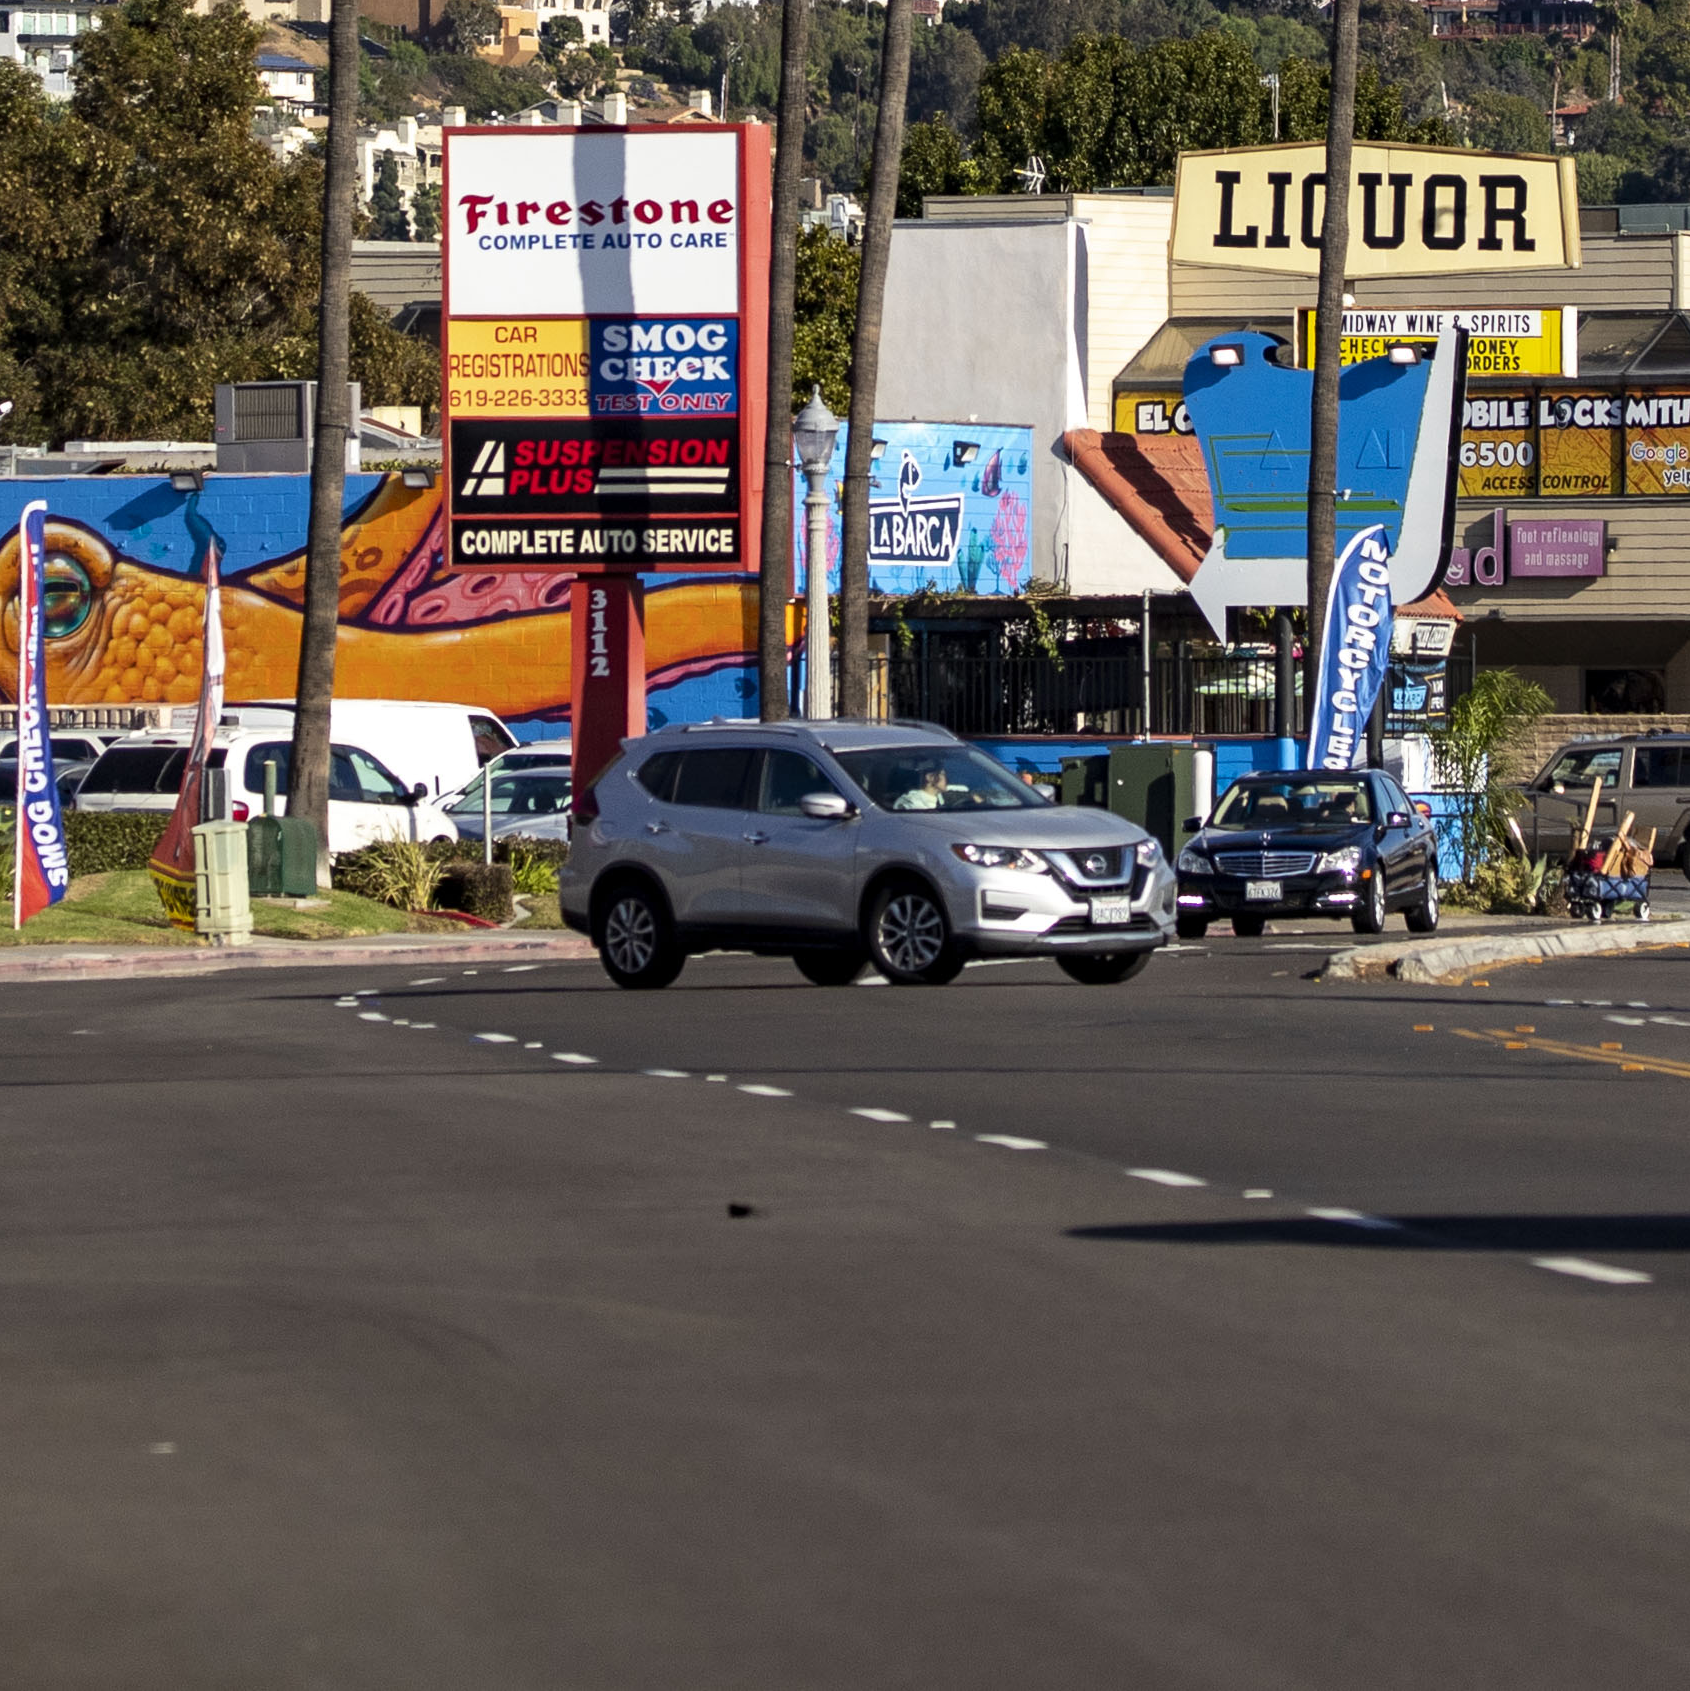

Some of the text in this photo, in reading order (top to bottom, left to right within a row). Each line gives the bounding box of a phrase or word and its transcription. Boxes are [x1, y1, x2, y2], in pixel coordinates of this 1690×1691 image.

[459, 194, 735, 235] Firestone
[478, 232, 728, 251] COMPLETE AUTO CARE
[494, 326, 538, 344] CAR
[1471, 315, 1530, 334] SPIRITS
[602, 323, 728, 353] SMOG
[1340, 338, 1401, 353] CHECK
[449, 353, 590, 378] REGISTRATIONS
[599, 355, 731, 382] CHECK
[450, 389, 590, 408] 619-226-3333
[596, 392, 733, 412] TEST ONLY
[1138, 403, 1169, 431] EL
[514, 438, 730, 466] SUSPENSION
[1460, 440, 1534, 467] 6500
[1630, 441, 1688, 465] Google
[509, 468, 594, 495] PLUS
[1482, 474, 1610, 491] ACCESS CONTROL
[461, 528, 734, 555] COMPLETE AUTO SERVICE
[892, 513, 953, 558] BARCA
[1517, 527, 1538, 544] foot
[1541, 527, 1599, 547] reflexology
[1525, 549, 1589, 570] and massage
[590, 589, 610, 677] 3112
[27, 800, 69, 888] SMOG
